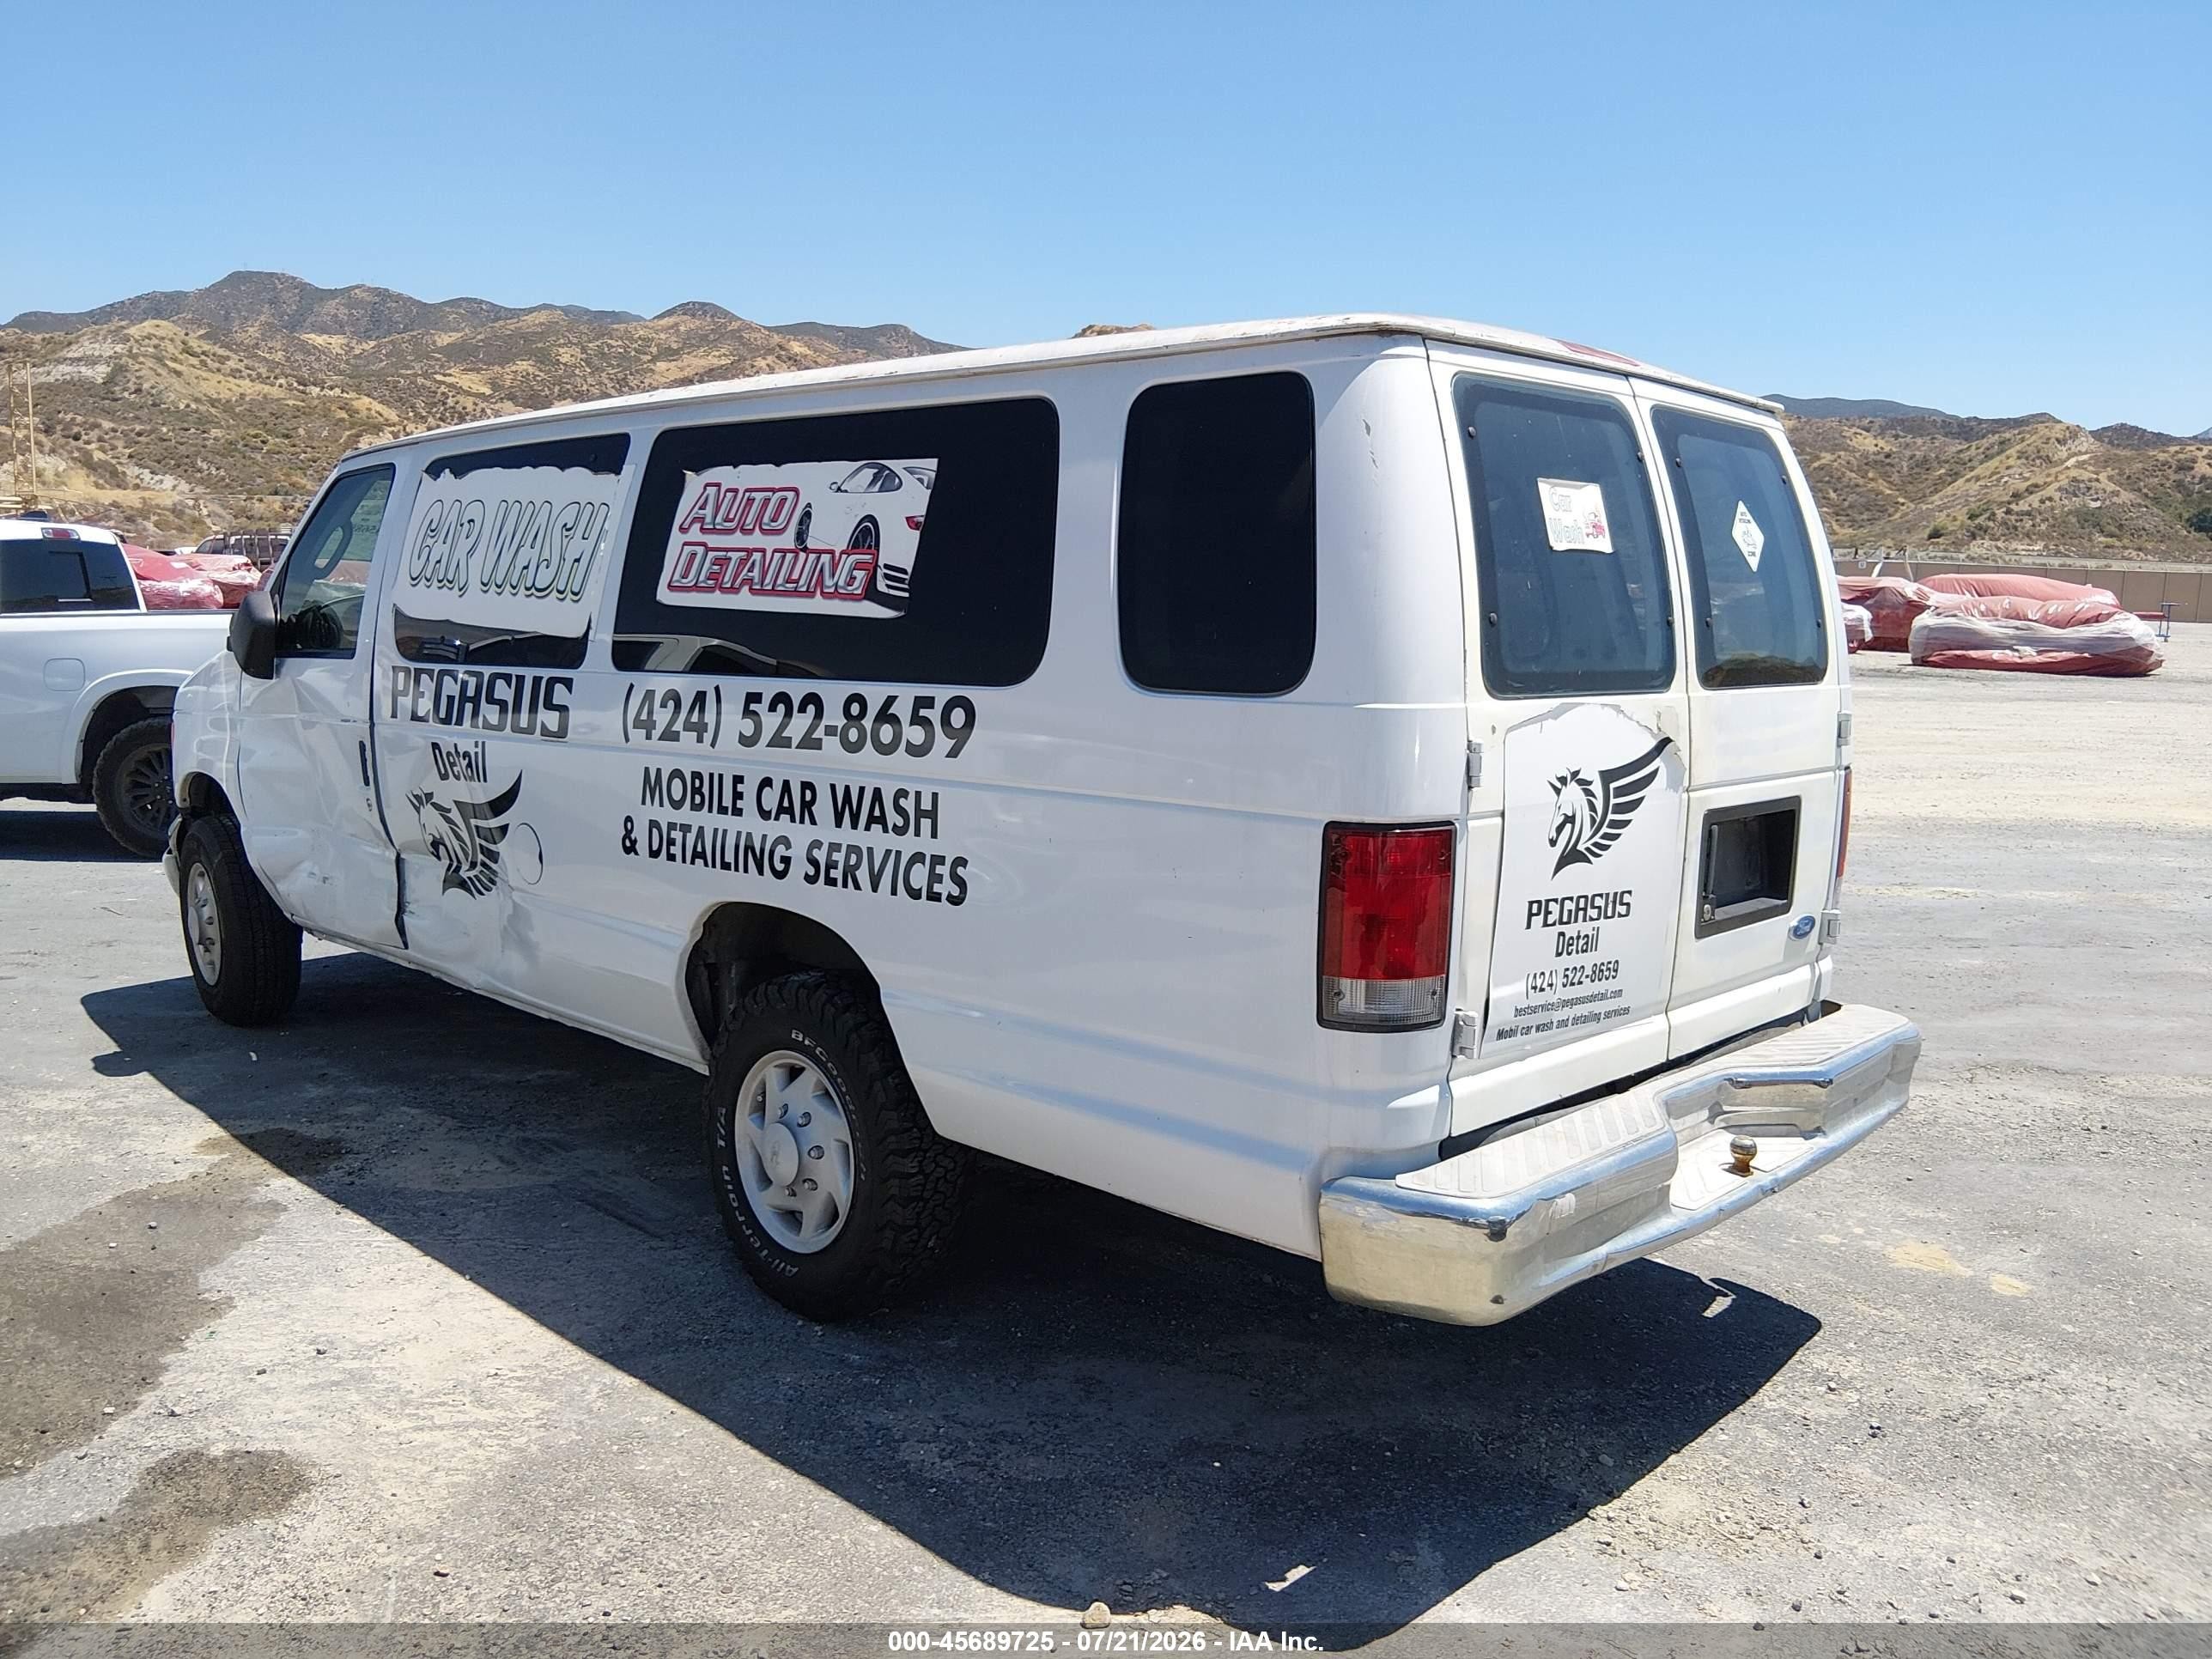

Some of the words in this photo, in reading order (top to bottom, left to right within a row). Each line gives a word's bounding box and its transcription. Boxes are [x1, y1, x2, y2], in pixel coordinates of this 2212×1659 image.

[678, 483, 800, 535] AUTO
[409, 499, 486, 597] CAR
[480, 500, 611, 603] WASH
[667, 541, 879, 601] DETAILING
[391, 665, 574, 739] PEGASUS
[622, 682, 723, 750] (424)
[738, 691, 977, 759] 522-8659
[430, 740, 488, 783] Detail
[641, 766, 745, 817] MOBILE
[756, 776, 818, 826] CAR
[830, 783, 939, 840] WASH
[622, 815, 640, 856] &
[648, 818, 793, 881] DETAILING
[804, 839, 969, 907] SERVICES
[1525, 890, 1633, 930] PEGASUS
[1554, 927, 1601, 957] Detail
[1514, 988, 1624, 1018] bestservice@pegasusdetail.com
[1525, 969, 1559, 1000] (424)
[1561, 959, 1620, 988] 522-8659
[1496, 1024, 1519, 1041] Mobil
[1520, 1024, 1534, 1036] car
[1534, 1018, 1553, 1033] wash
[1555, 1015, 1569, 1029] and
[1571, 1011, 1601, 1027] detailing
[1602, 1006, 1631, 1020] services
